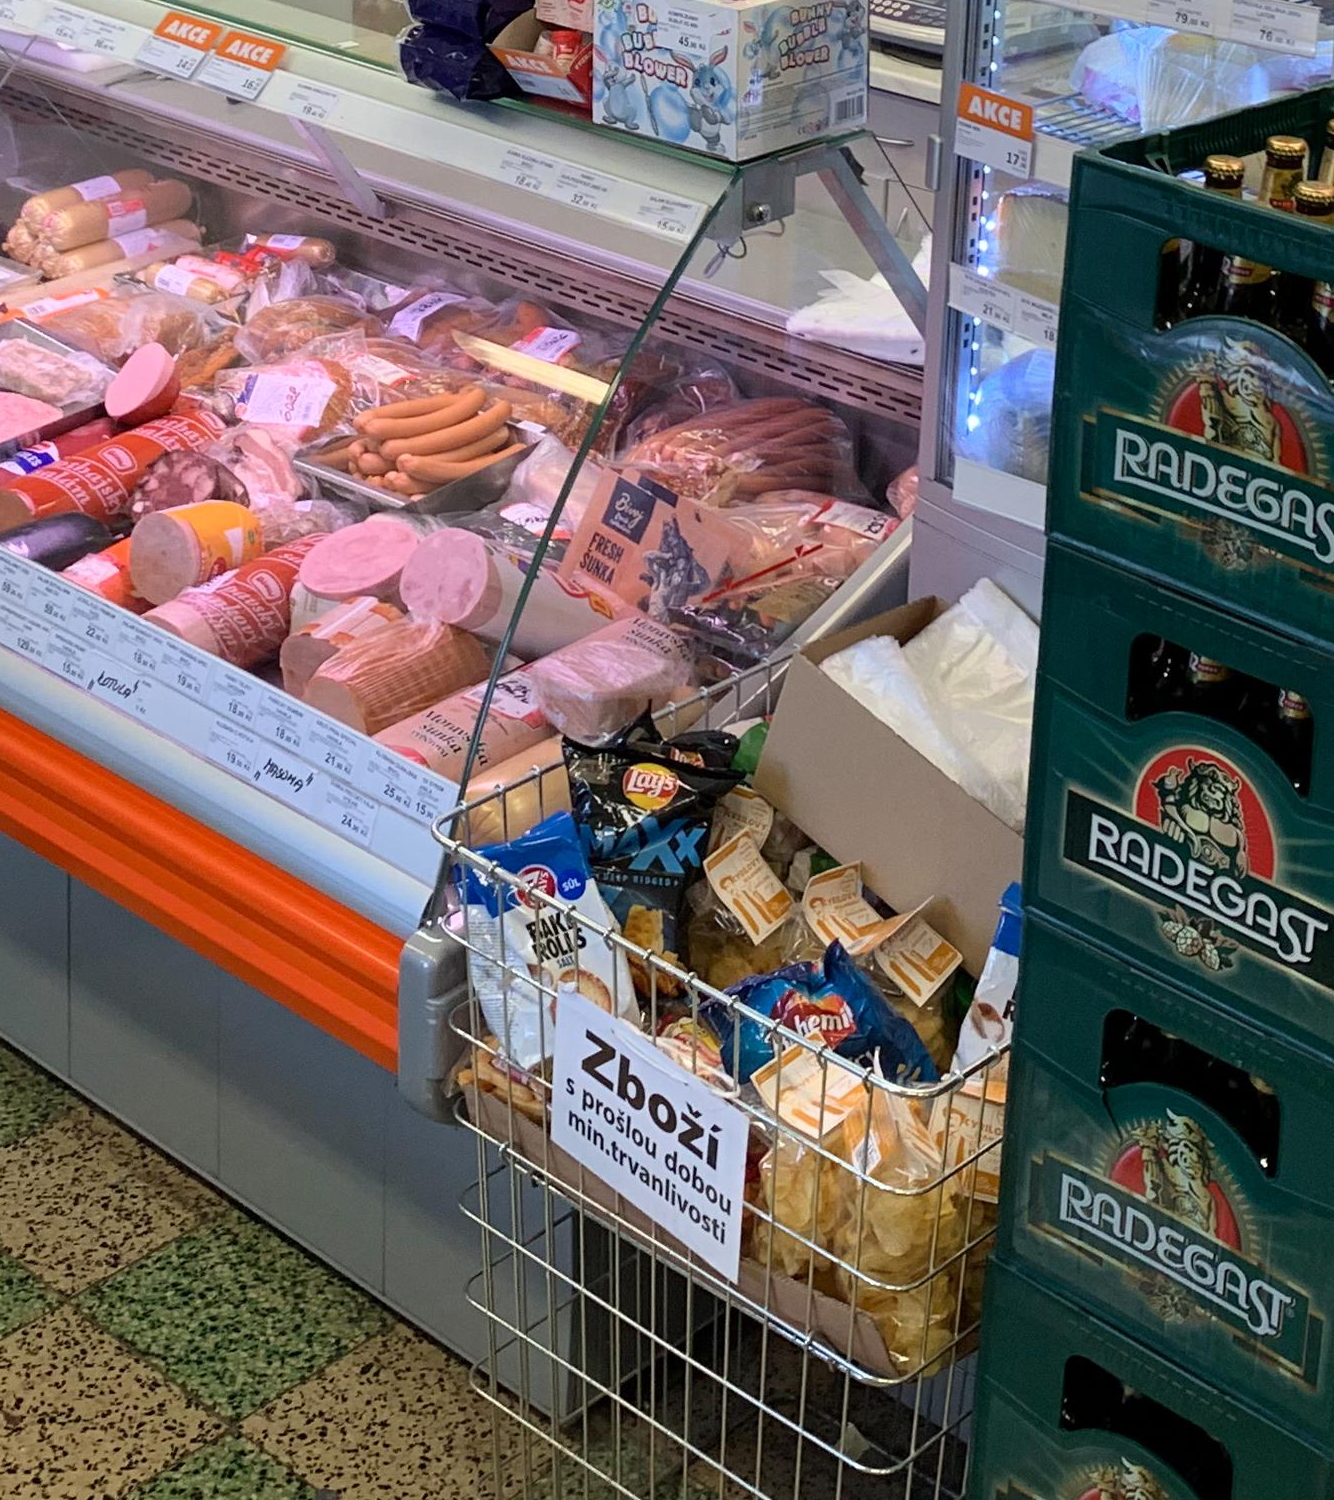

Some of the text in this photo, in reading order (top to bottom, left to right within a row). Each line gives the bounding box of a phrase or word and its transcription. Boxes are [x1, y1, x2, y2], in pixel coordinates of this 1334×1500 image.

[164, 19, 210, 45] AKCE
[225, 38, 274, 65] AKCE
[623, 52, 688, 89] BLOWER
[968, 94, 1023, 131] AKCE
[588, 531, 624, 564] FRESH
[1089, 813, 1331, 964] RADEGAST
[581, 1029, 723, 1170] Zboží
[566, 1076, 733, 1217] s prošlou dobou
[568, 1110, 726, 1246] min.trvanlivosti
[1060, 1173, 1296, 1337] RADEGAST
